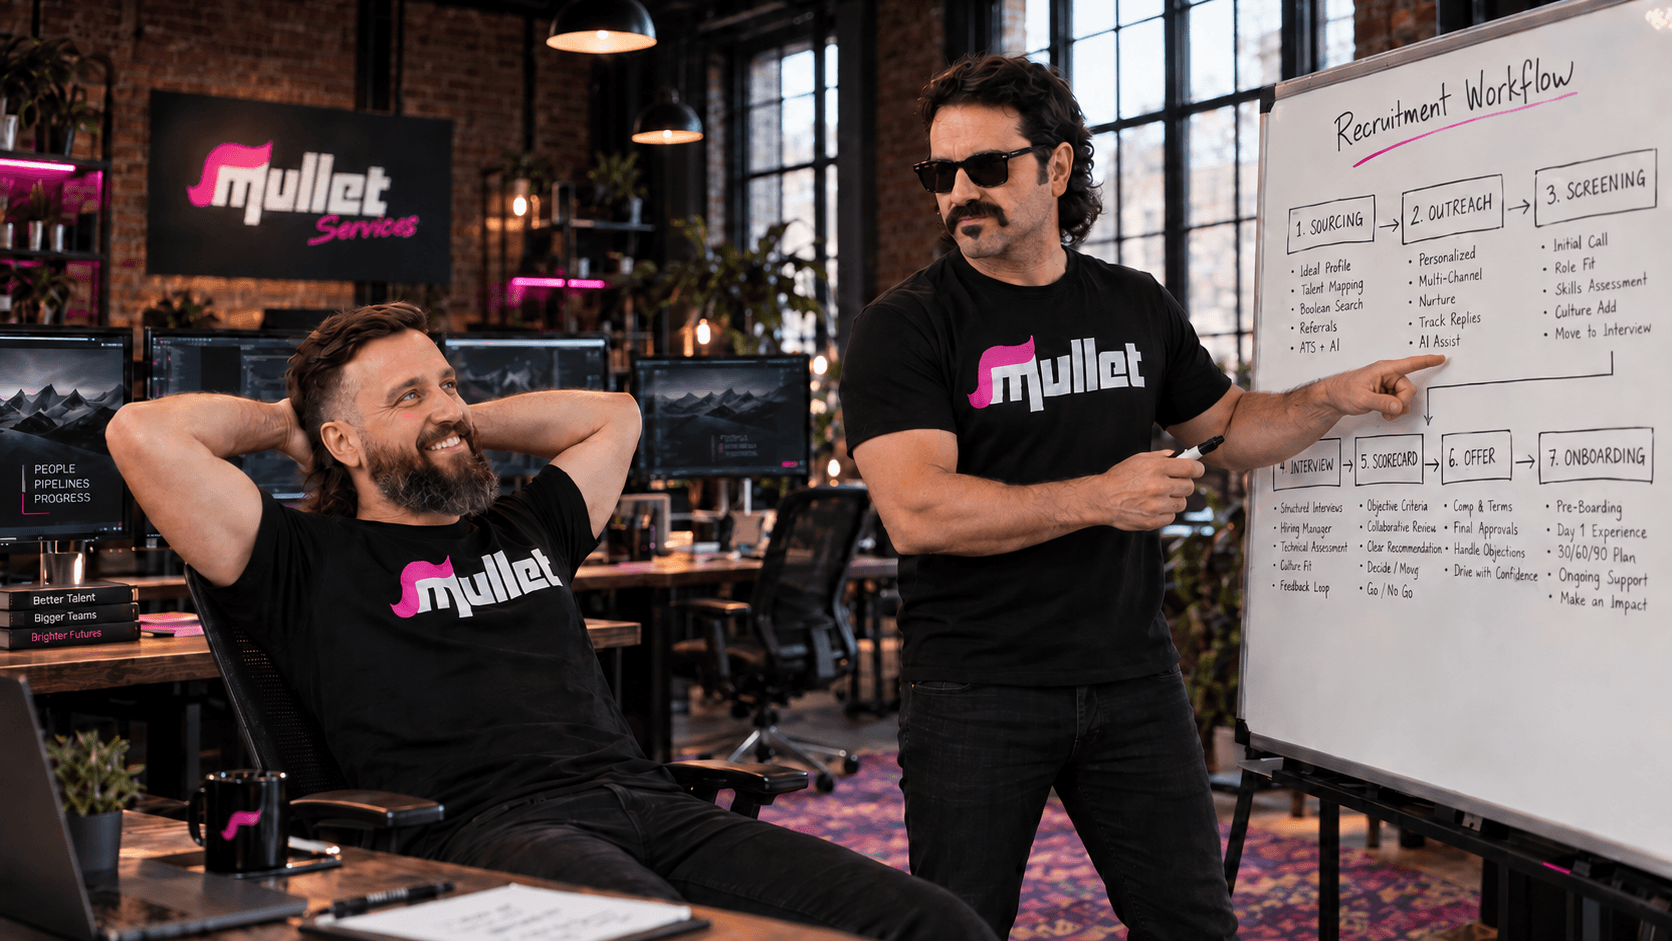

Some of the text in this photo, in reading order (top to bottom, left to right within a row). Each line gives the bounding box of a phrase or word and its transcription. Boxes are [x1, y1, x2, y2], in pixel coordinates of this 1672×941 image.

[1334, 58, 1574, 151] Recruitment Workflow
[1546, 169, 1646, 205] 3. SCREENING
[1410, 193, 1492, 226] 2. OUTREACH
[307, 214, 419, 246] Services
[1296, 211, 1363, 237] 1. SOURCING
[1553, 232, 1608, 252] Initial Call
[1419, 245, 1476, 267] Personalized
[1301, 259, 1351, 277] Ideal Profile
[1555, 257, 1595, 274] Role Fit
[1419, 268, 1483, 287] Multi-Channel
[1555, 272, 1647, 295] Skills Assessment
[1301, 279, 1363, 296] Talent Mapping
[1300, 298, 1363, 315] Boolean Search
[1419, 294, 1456, 307] Nurture
[1555, 299, 1616, 319] Culture Add
[1300, 320, 1337, 334] Referrals
[1419, 311, 1481, 329] Track Replies
[1555, 322, 1651, 340] Move to Interview
[1300, 338, 1340, 353] ATS + AI
[1419, 334, 1460, 348] AI Assist
[1290, 458, 1334, 474] INTERVIEW
[1361, 451, 1418, 469] 5. SCORECARD
[1449, 447, 1495, 467] 6. OFFER
[1549, 447, 1646, 467] 7. ONBOARDING
[34, 464, 76, 474] PEOPLE
[34, 479, 90, 489] PIPELINES
[34, 493, 91, 503] PROGRESS
[1280, 502, 1342, 513] Structured Interviews
[1367, 499, 1428, 517] Objective Criteria
[1453, 500, 1512, 517] Comp & Terms
[1557, 499, 1622, 521] Pre-Boarding
[1280, 522, 1332, 538] Hiring Manager
[1367, 520, 1436, 533] Collaborative Review
[1454, 521, 1518, 539] Final Approvals
[1557, 523, 1647, 544] Day 1 Experience
[1280, 541, 1348, 553] Technical Assessment
[1367, 540, 1442, 554] Clear Recommendation
[1454, 543, 1525, 563] Handle Objections
[1558, 544, 1636, 563] 30/60/90 Plan
[1304, 560, 1312, 571] Fit
[1367, 561, 1391, 574] Decide
[1454, 564, 1538, 582] Drive with Confidence
[1559, 567, 1648, 592] Ongoing Support
[1280, 580, 1330, 599] Feedback Loop
[1367, 582, 1378, 596] Go
[1388, 584, 1398, 596] No
[1402, 584, 1413, 598] Go
[33, 593, 96, 605] Better Talent
[1561, 591, 1647, 616] Make an Impact
[34, 611, 97, 624] Bigger Teams
[31, 629, 102, 643] Brighter Futures
